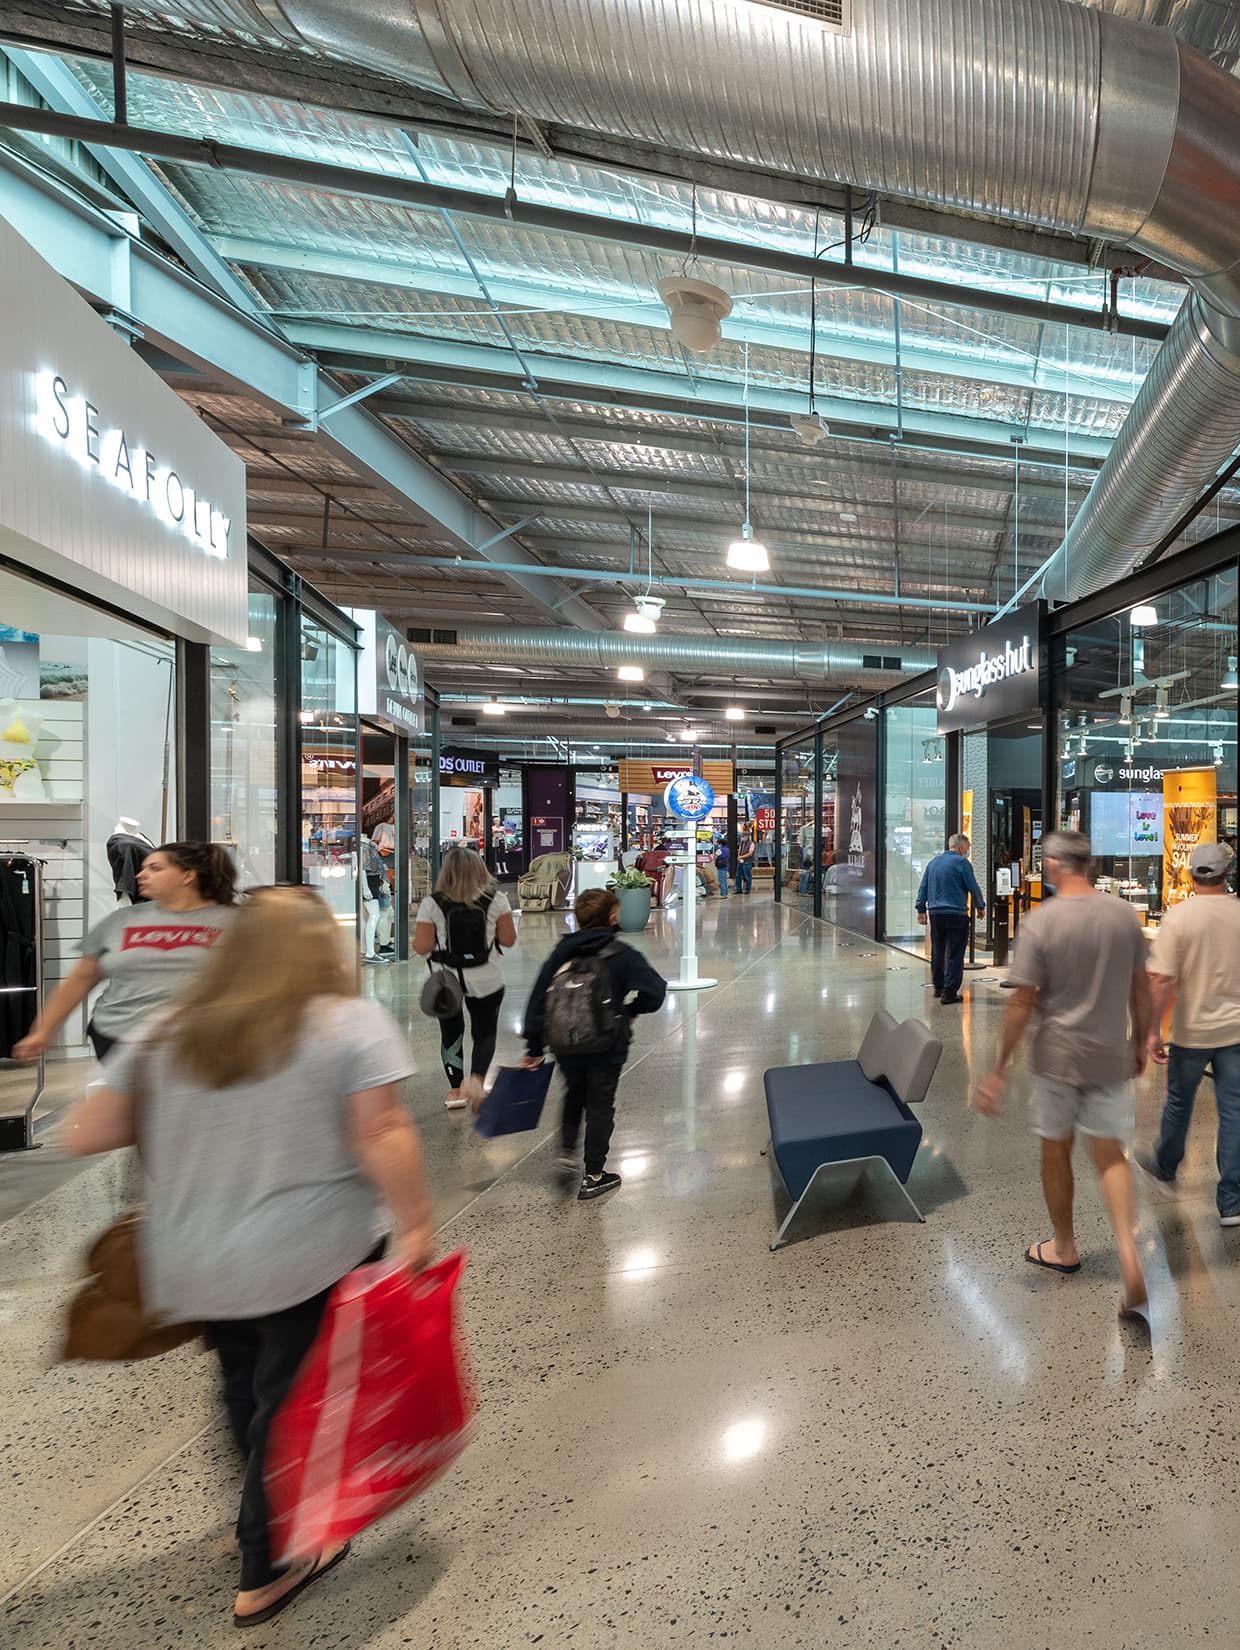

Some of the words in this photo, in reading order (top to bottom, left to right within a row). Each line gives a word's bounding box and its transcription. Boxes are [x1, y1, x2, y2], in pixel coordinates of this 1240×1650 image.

[52, 376, 231, 558] SEAFOLLY
[455, 758, 485, 774] OUTLET
[1175, 833, 1199, 842] SUMMER
[1172, 851, 1193, 869] SAL
